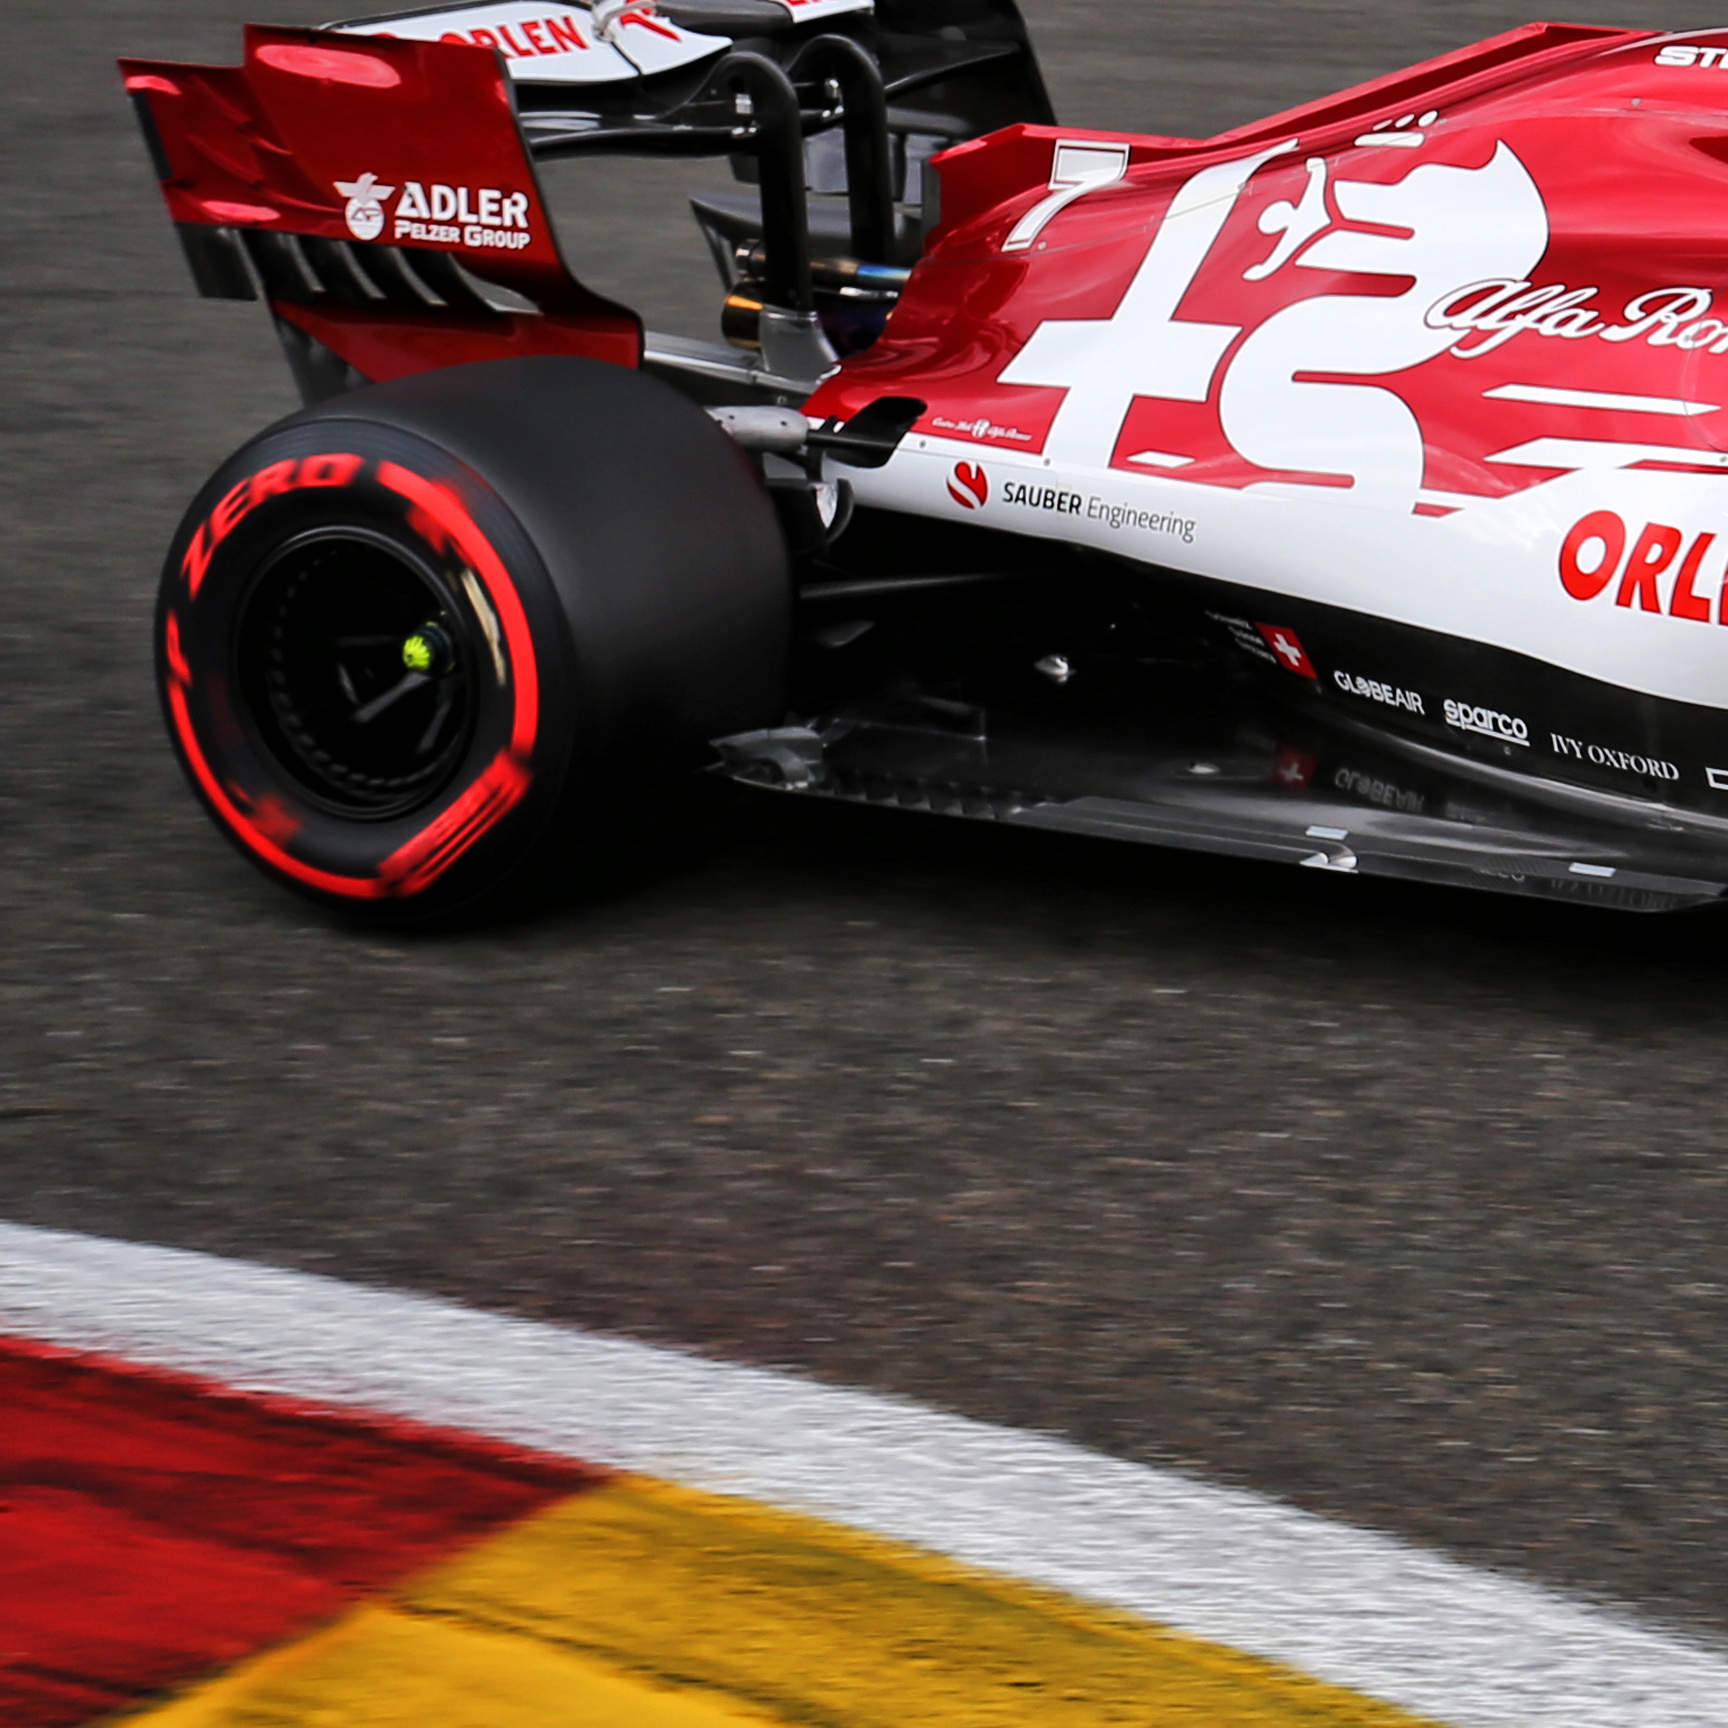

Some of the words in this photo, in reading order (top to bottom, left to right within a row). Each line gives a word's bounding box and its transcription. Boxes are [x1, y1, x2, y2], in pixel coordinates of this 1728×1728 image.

[394, 181, 528, 229] ADLER
[1002, 139, 1130, 253] 7
[1424, 278, 1604, 358] Alfa
[180, 452, 366, 603] ZERO
[1003, 481, 1083, 516] SAUBER
[1087, 496, 1197, 544] Engineering
[1333, 670, 1425, 715] GLOBEAIR
[1443, 699, 1528, 740] sparco
[1550, 732, 1585, 760] IVY
[1587, 744, 1680, 781] OXFORD
